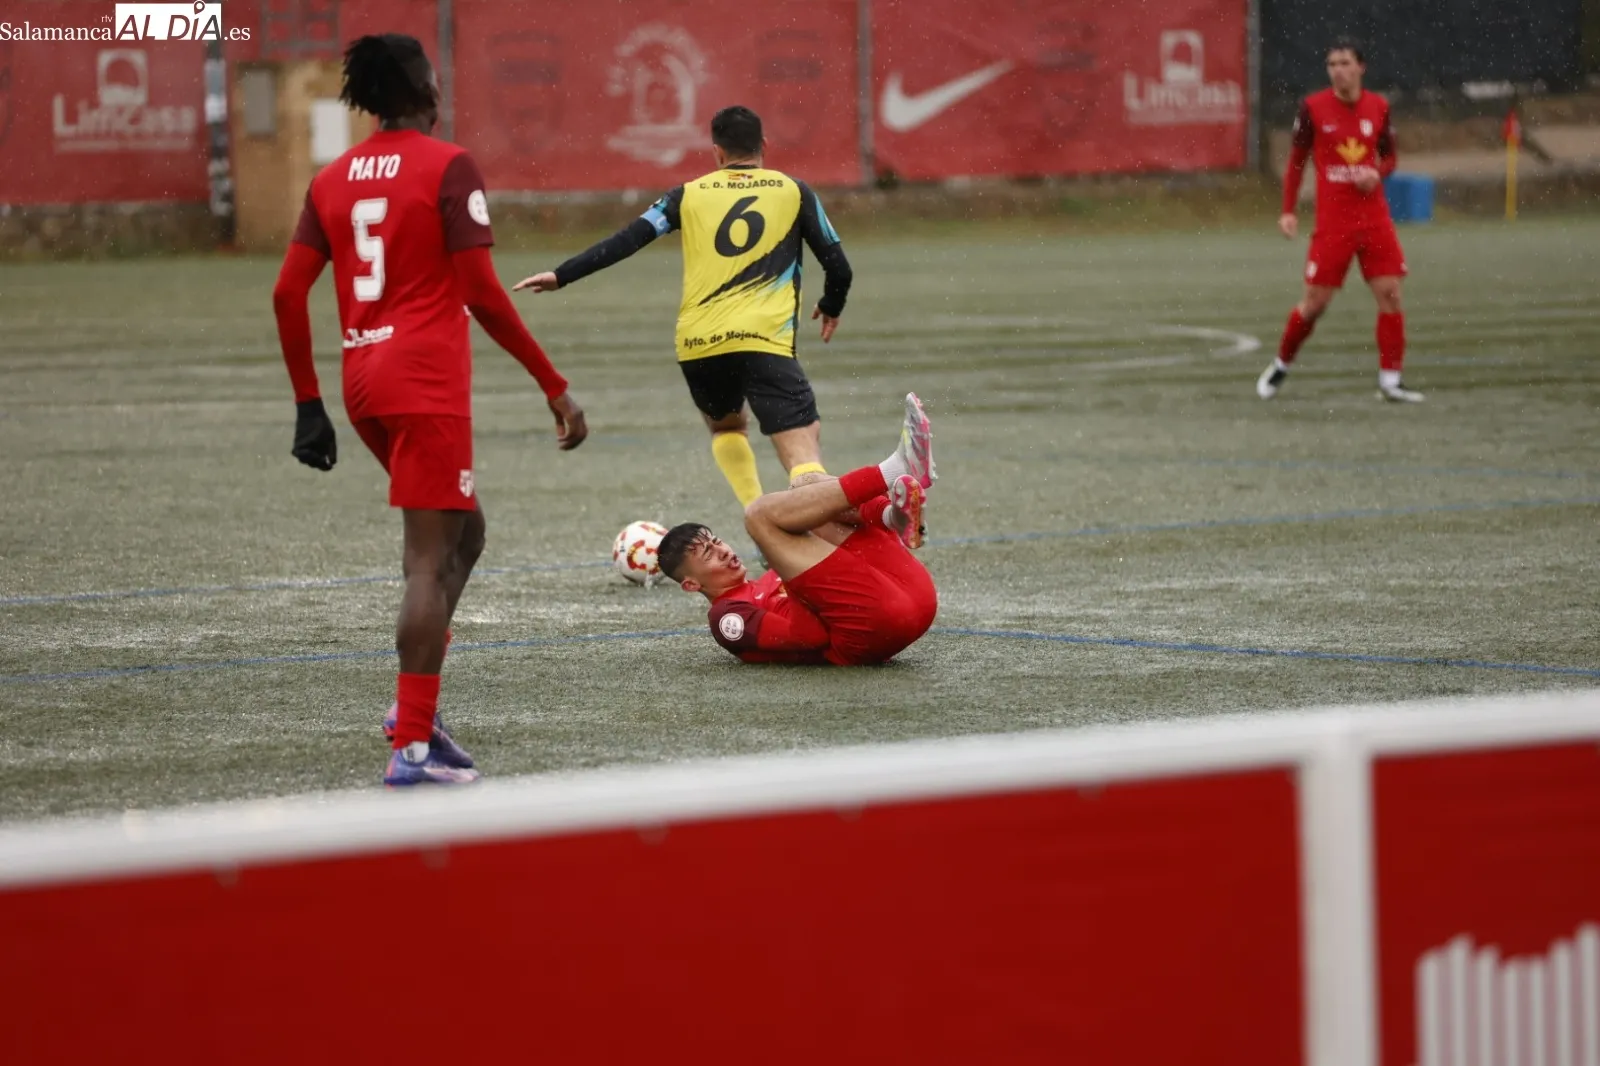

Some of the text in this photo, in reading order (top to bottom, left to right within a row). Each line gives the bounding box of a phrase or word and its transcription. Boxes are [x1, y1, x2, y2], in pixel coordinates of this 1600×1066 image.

[347, 154, 401, 181] MAYO
[727, 179, 784, 189] MOJADOS
[714, 196, 765, 257] 6
[351, 197, 388, 302] 5
[710, 334, 723, 343] de
